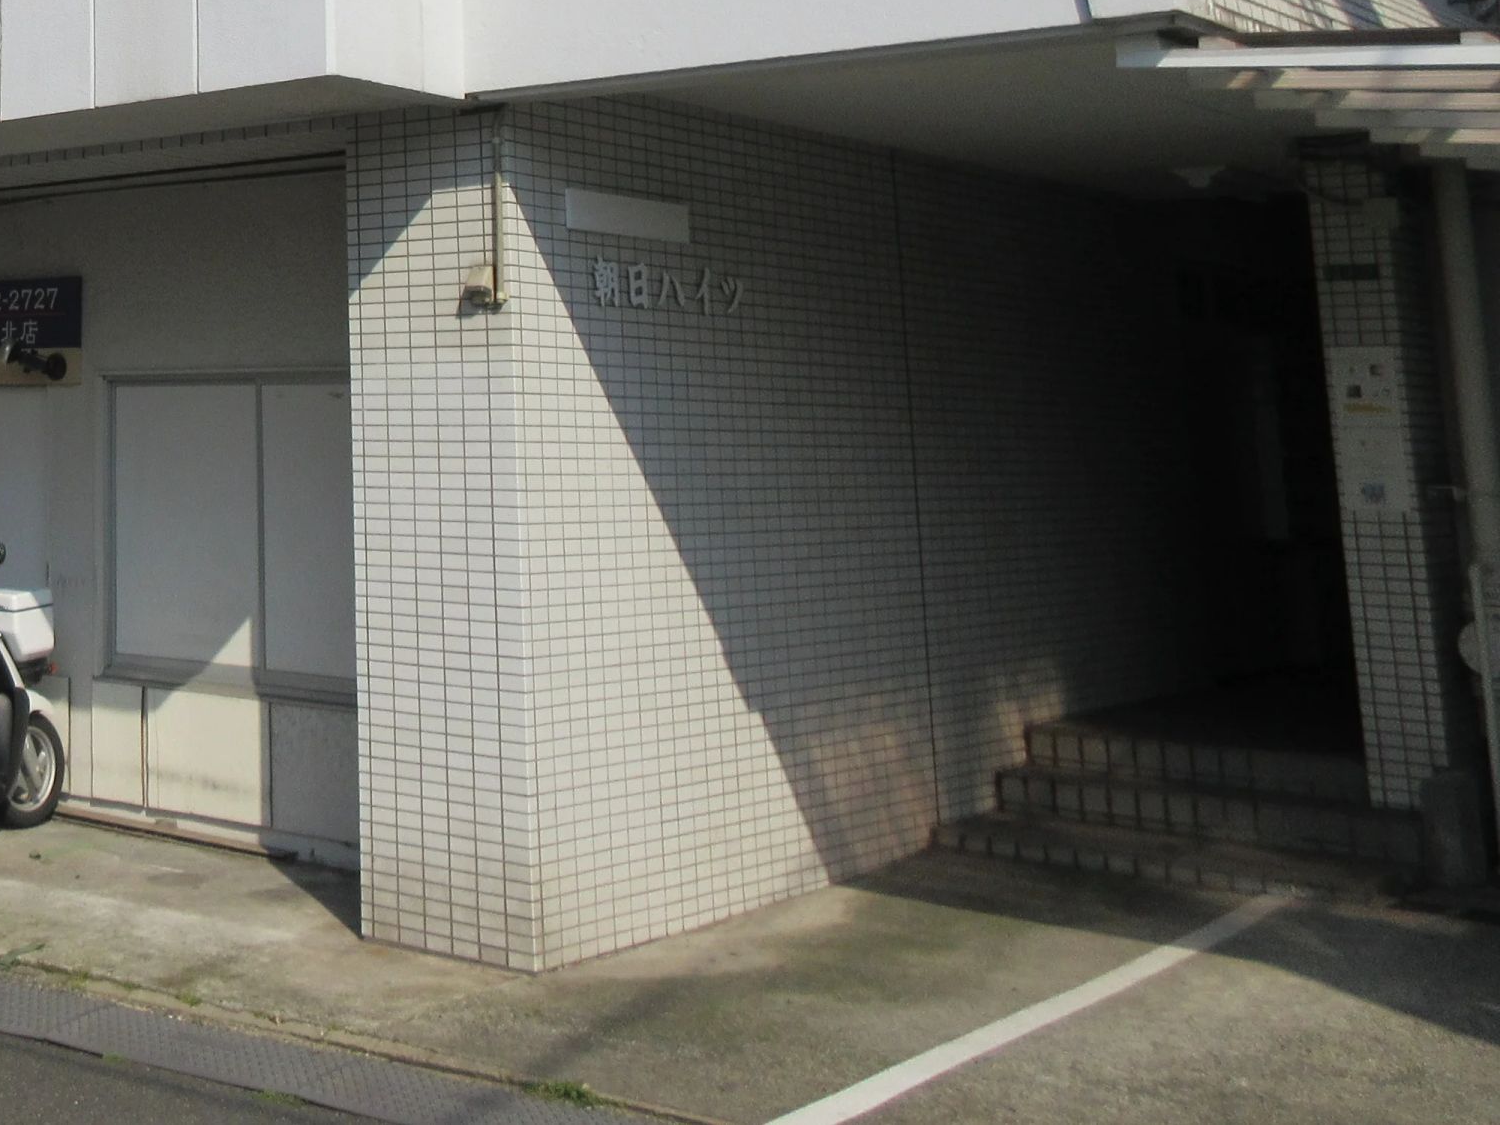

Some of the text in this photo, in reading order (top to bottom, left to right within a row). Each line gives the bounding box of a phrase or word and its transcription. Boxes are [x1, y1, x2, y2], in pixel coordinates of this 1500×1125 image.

[592, 254, 744, 316] 朝日ハイツ
